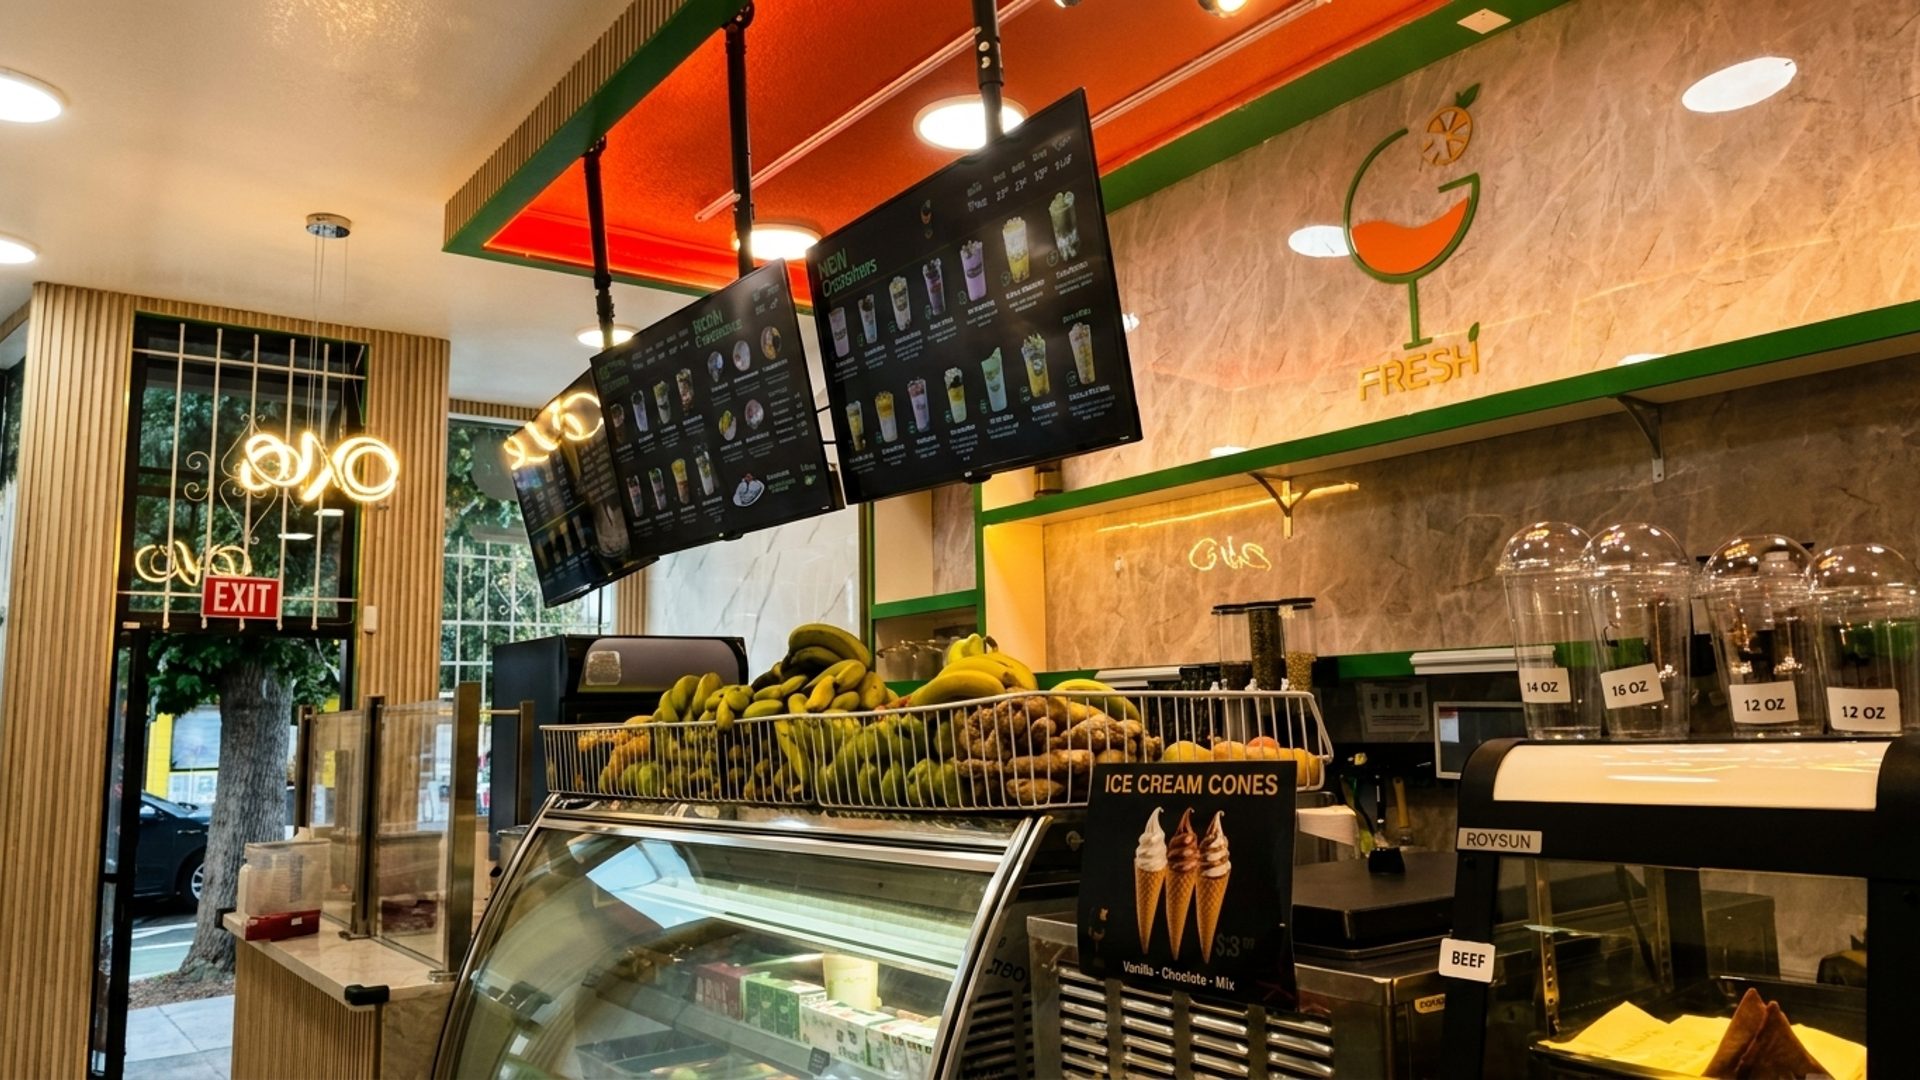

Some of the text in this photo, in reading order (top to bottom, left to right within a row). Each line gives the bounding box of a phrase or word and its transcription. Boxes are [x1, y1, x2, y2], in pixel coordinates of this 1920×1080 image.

[1359, 340, 1480, 401] FRESH
[213, 581, 272, 613] EXIT
[1526, 681, 1559, 693] 14 OZ
[1612, 680, 1649, 697] 16 OZ
[1744, 698, 1785, 712] 12 OZ
[1842, 706, 1886, 720] 12 OZ
[1105, 774, 1278, 795] ICE CREAM CONES
[1466, 832, 1531, 849] ROYSUN
[1451, 950, 1486, 968] BEEF
[1215, 976, 1235, 991] Mix
